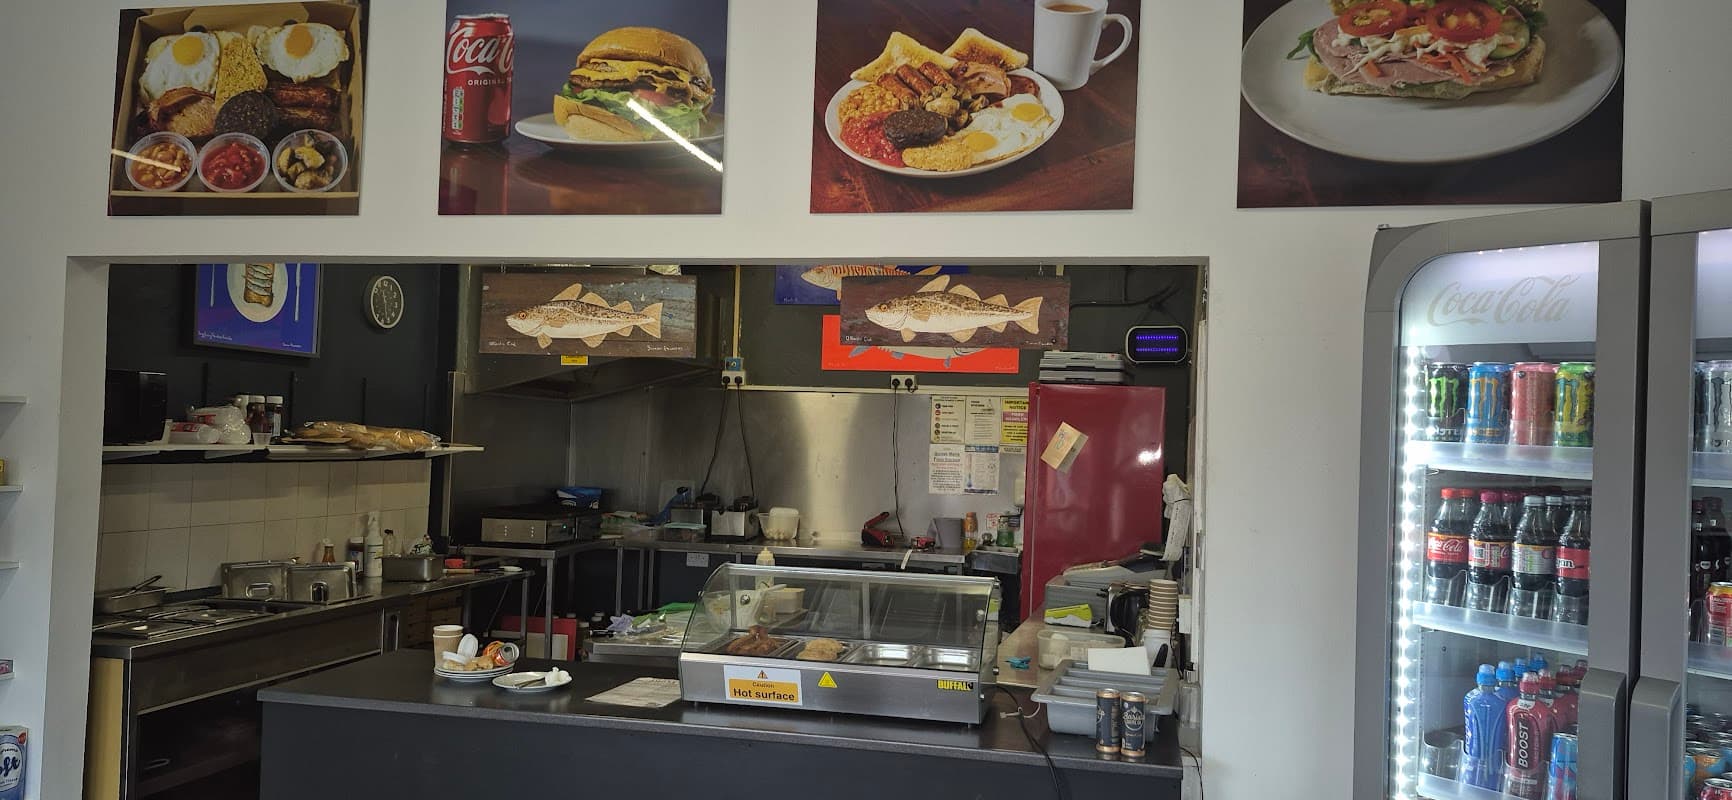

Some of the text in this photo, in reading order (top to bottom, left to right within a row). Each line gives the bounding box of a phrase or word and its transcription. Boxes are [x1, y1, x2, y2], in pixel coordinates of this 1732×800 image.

[752, 681, 775, 689] Caution
[733, 688, 795, 701] Hot surface
[1518, 722, 1529, 768] BOOST
